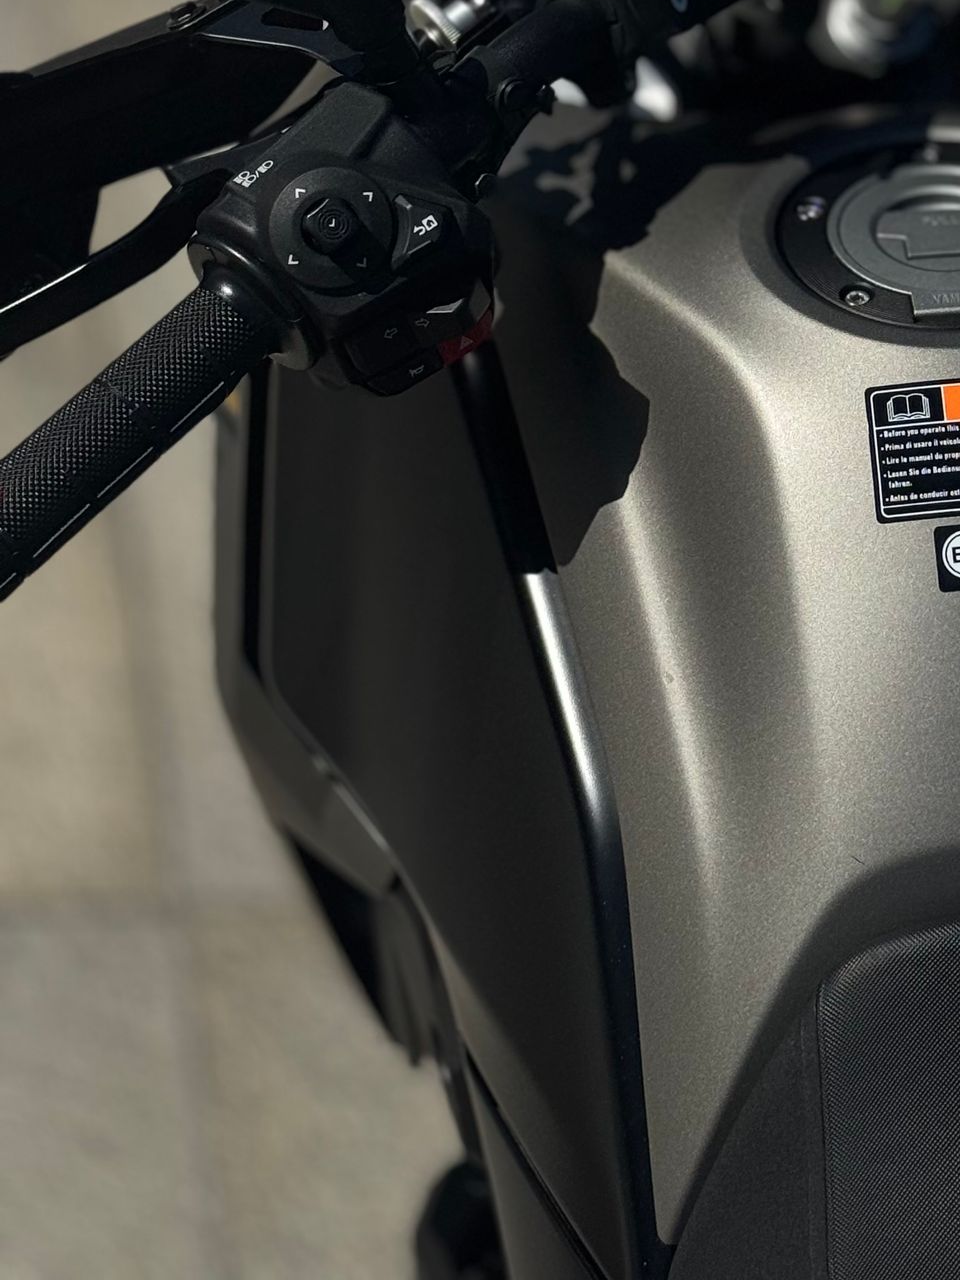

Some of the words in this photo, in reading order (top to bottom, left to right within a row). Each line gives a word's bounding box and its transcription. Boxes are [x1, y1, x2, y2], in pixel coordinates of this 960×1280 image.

[920, 426, 945, 435] operate
[885, 443, 904, 451] Prima
[901, 455, 907, 463] le
[909, 453, 933, 462] manuel
[890, 494, 908, 502] Antes
[920, 490, 948, 499] conducir
